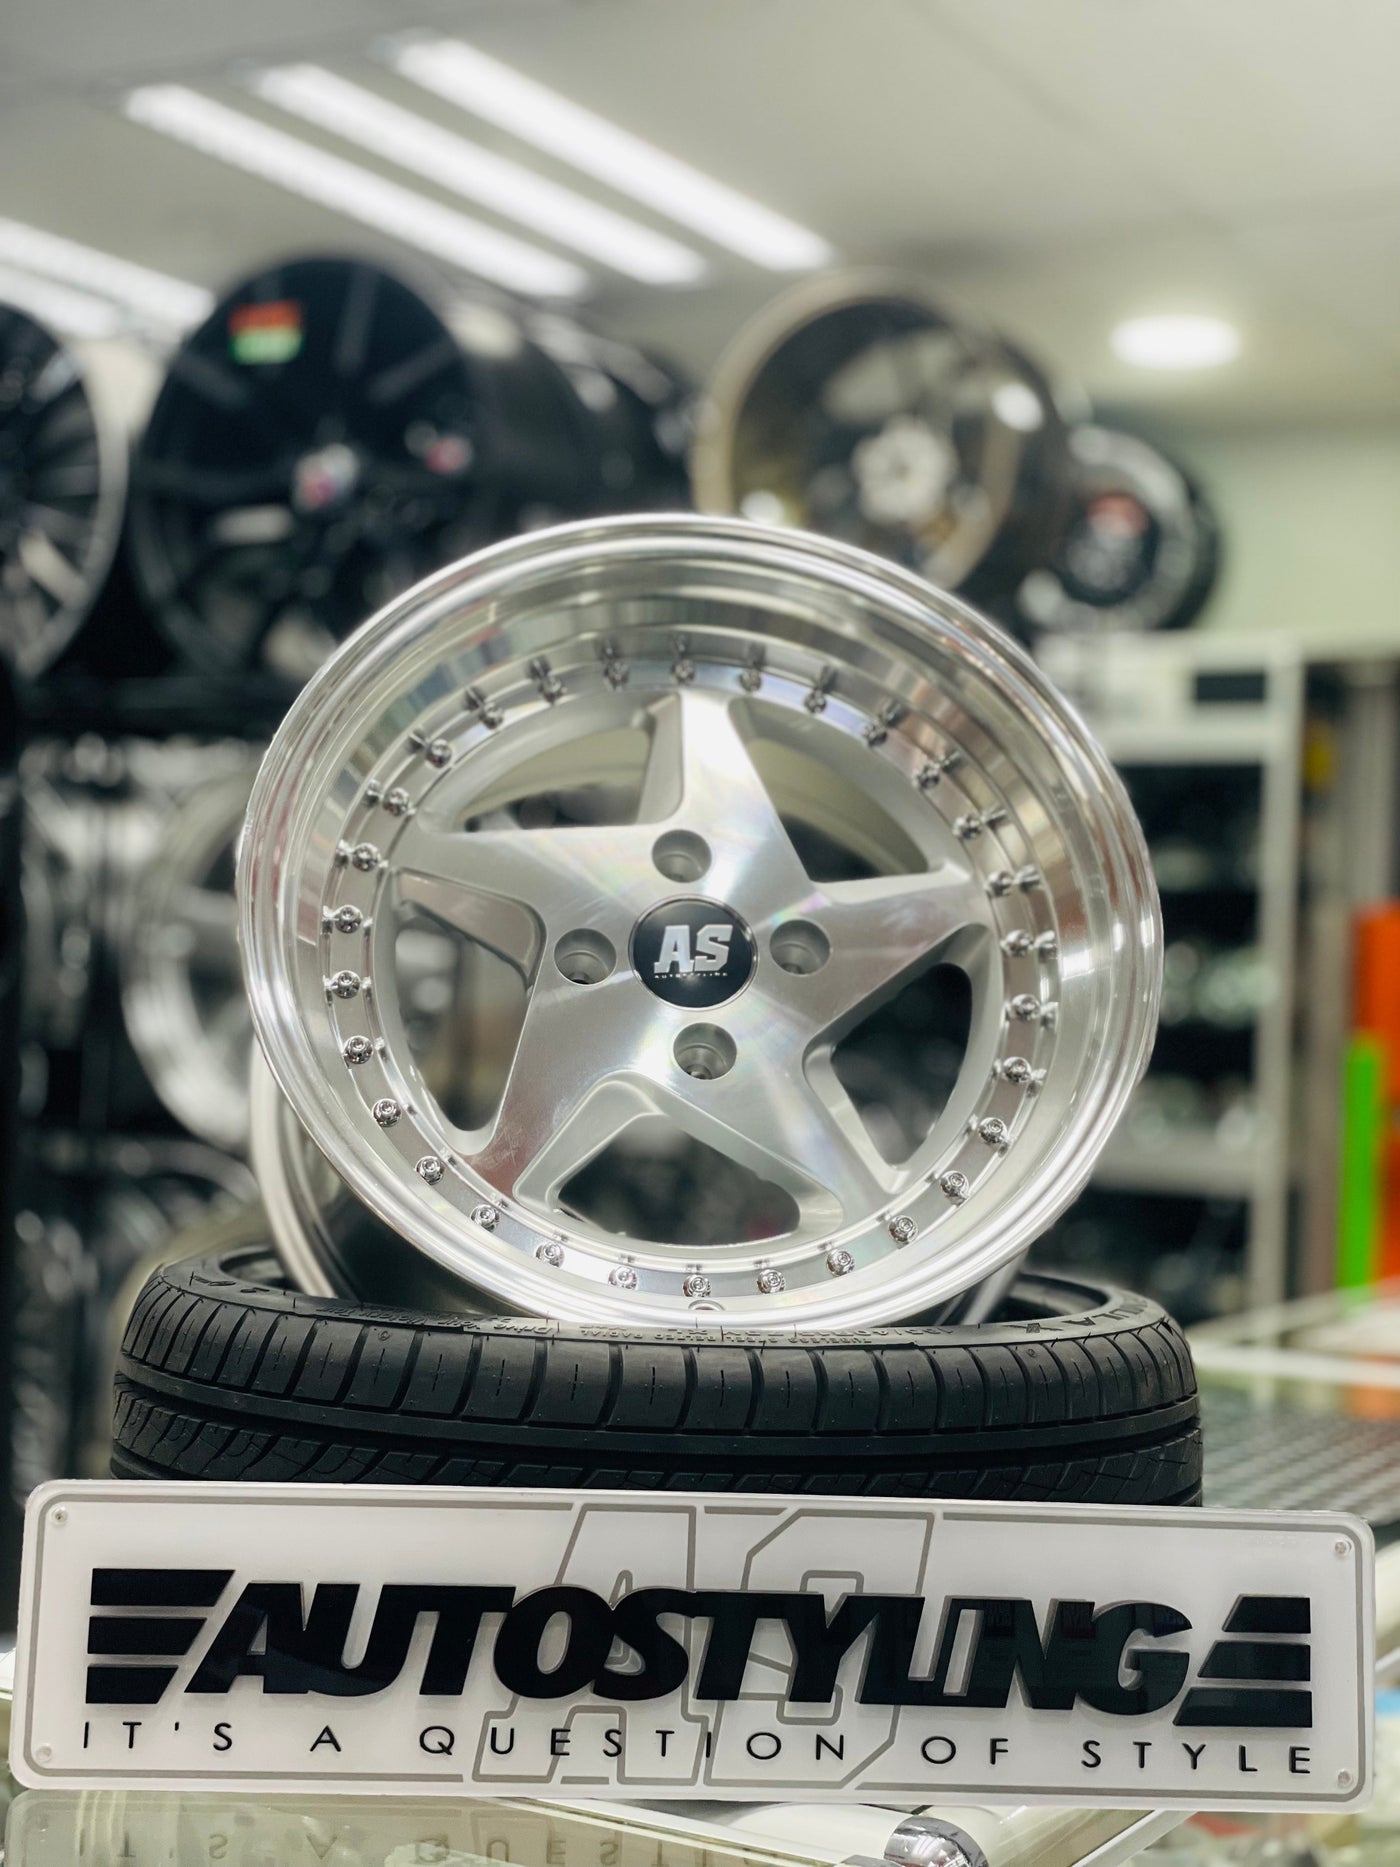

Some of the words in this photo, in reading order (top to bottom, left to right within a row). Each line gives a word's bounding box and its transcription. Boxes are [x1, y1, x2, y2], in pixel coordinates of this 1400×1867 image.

[653, 924, 734, 974] AS
[184, 1582, 1193, 1717] AUTOSTYLING
[83, 1721, 233, 1752] IT'S
[309, 1725, 342, 1753] A
[419, 1725, 846, 1762] QUESTION
[920, 1736, 1010, 1766] OF
[1081, 1740, 1311, 1774] STYLE
